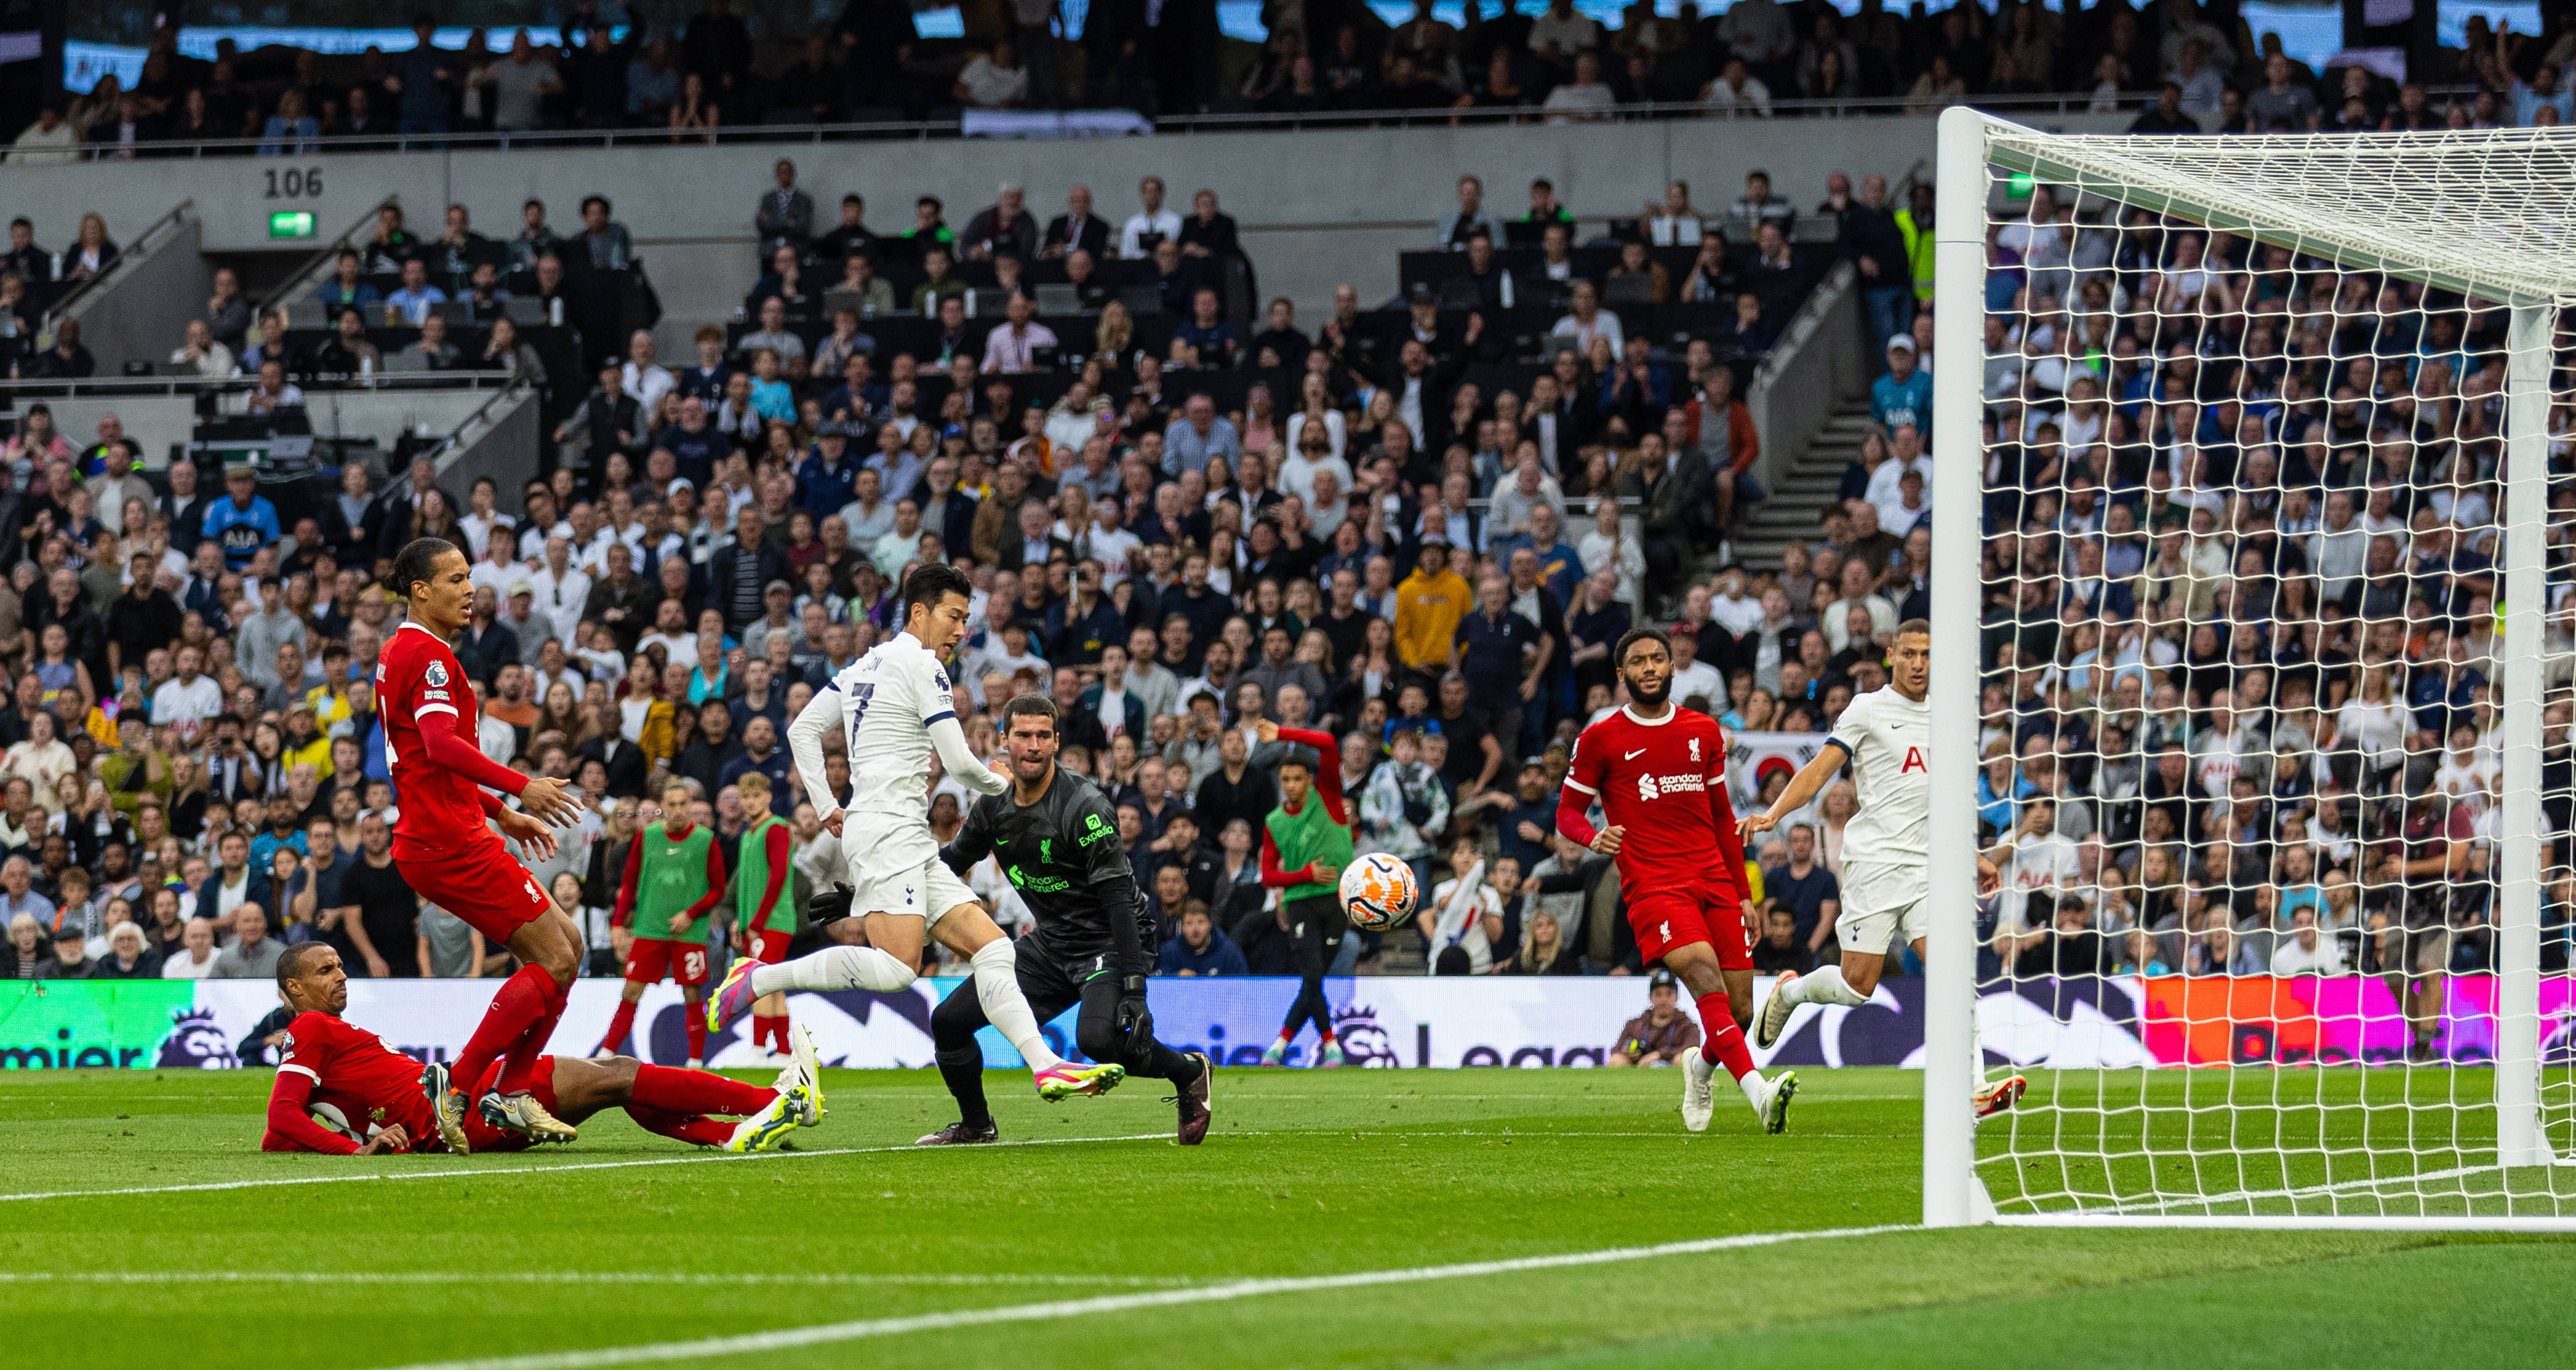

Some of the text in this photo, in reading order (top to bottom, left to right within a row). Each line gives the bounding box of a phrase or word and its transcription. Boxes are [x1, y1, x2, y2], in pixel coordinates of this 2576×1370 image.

[265, 167, 323, 198] 106
[224, 529, 259, 549] AIA
[852, 682, 875, 758] 7
[1658, 773, 1702, 786] standard
[1661, 781, 1705, 794] chartered
[684, 951, 706, 981] 21
